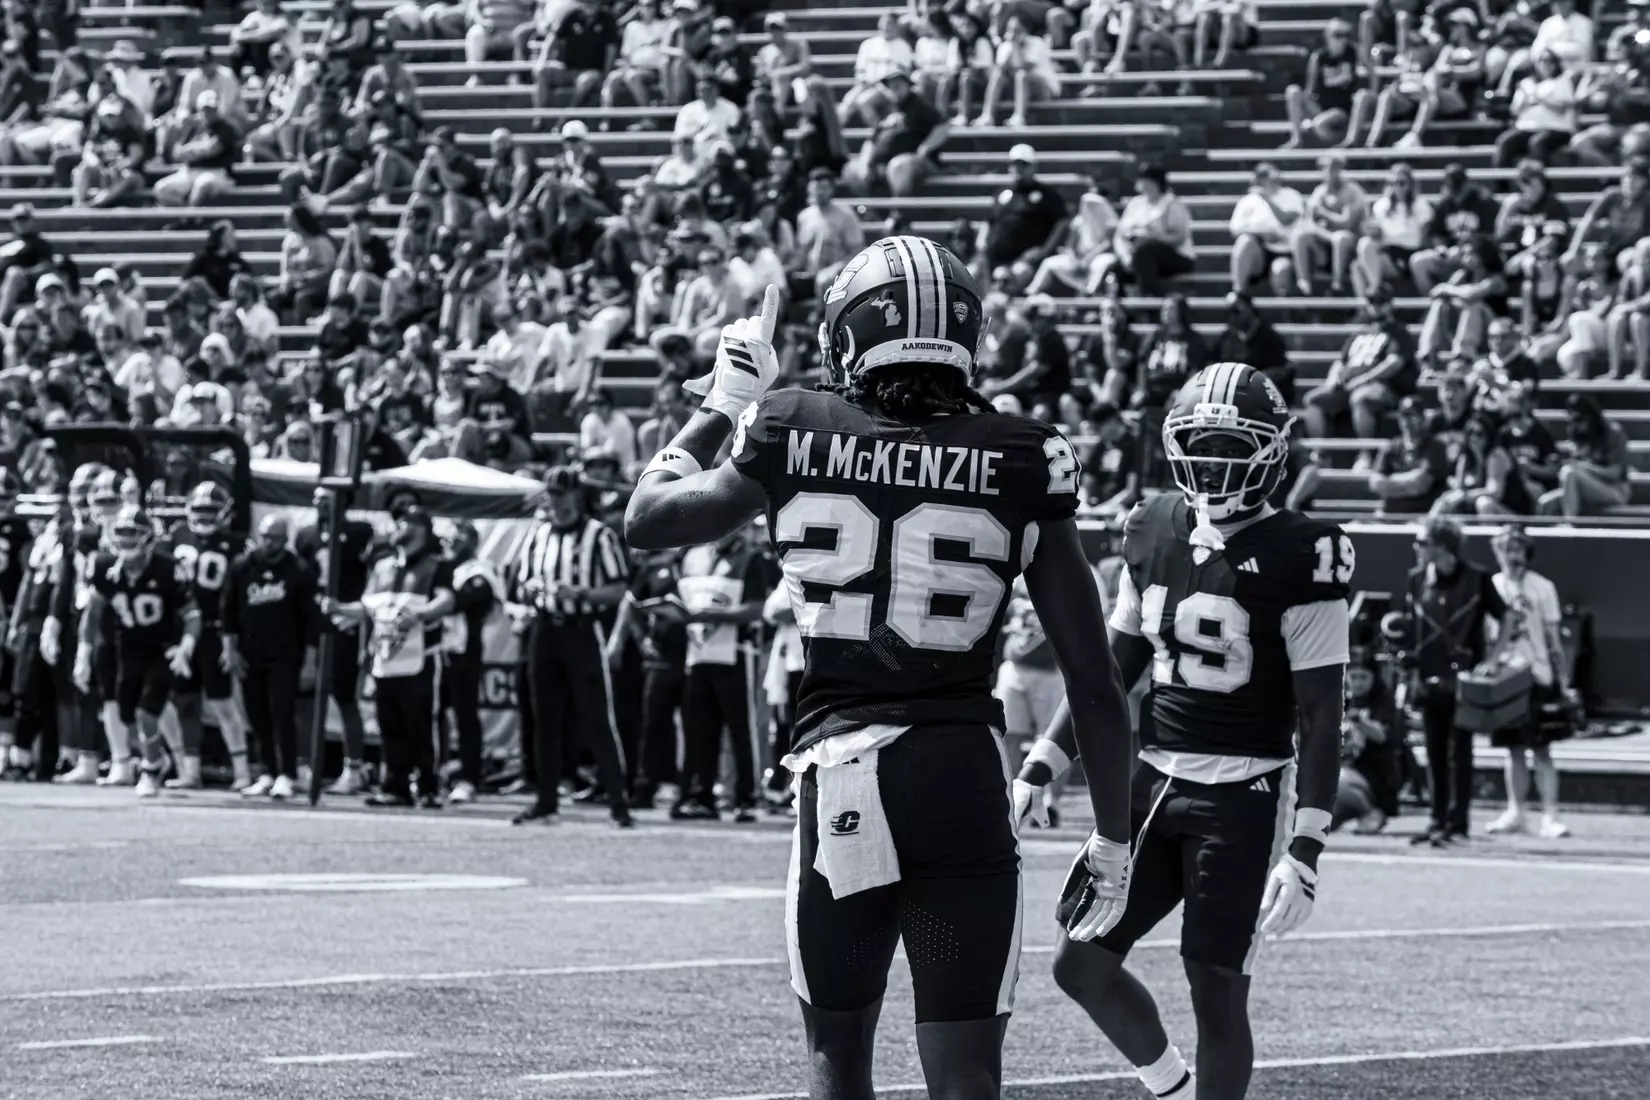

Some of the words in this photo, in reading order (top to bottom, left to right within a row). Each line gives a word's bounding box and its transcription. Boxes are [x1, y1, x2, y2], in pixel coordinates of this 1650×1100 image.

[901, 342, 953, 352] AAKODEWIN
[786, 430, 818, 476] M.
[826, 433, 1004, 495] McKENZIE
[1043, 435, 1078, 494] 2
[776, 491, 1011, 652] 26
[1312, 534, 1356, 583] 19
[111, 591, 164, 628] 10
[1140, 583, 1254, 694] 19
